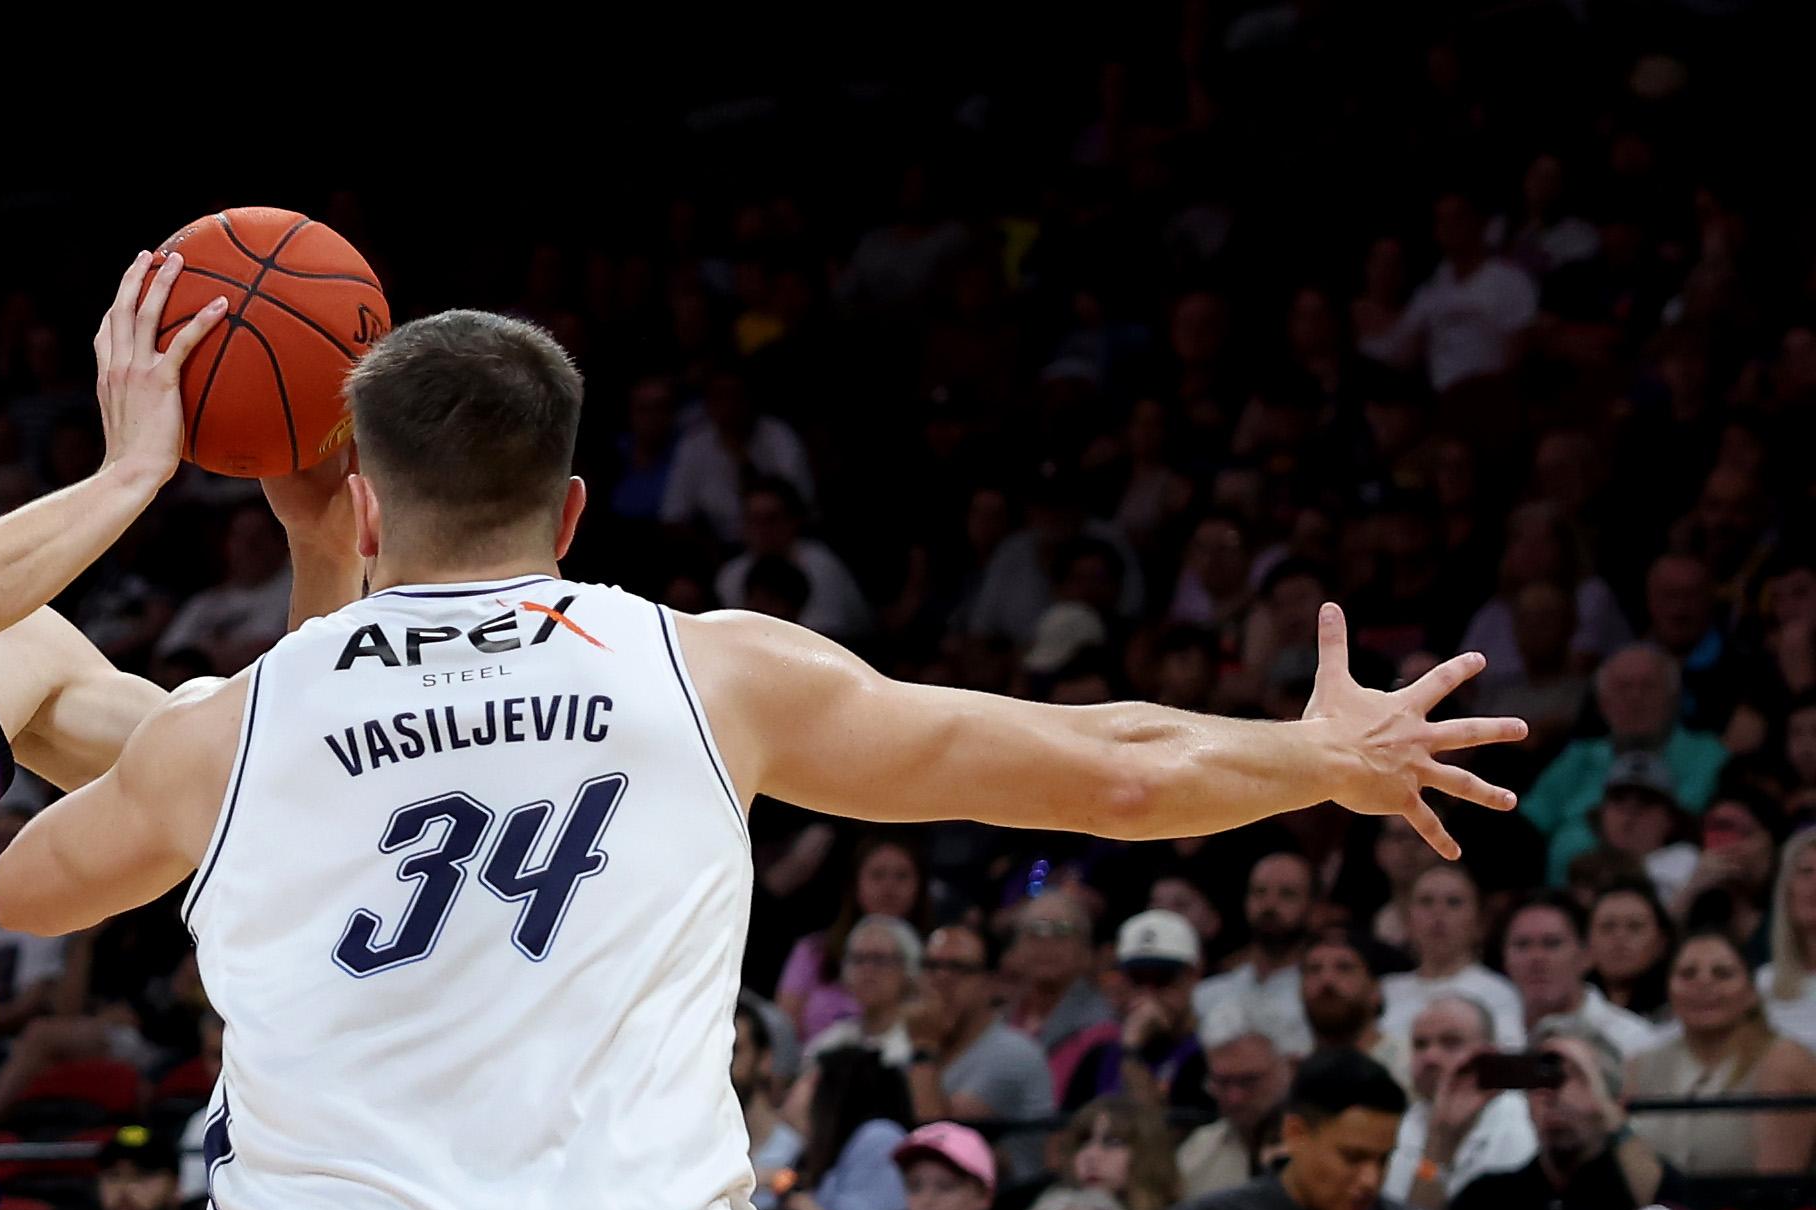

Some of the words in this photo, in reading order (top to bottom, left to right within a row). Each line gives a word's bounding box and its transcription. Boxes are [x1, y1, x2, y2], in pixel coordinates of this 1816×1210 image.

[422, 664, 512, 688] STEEL
[323, 694, 614, 777] VASILJEVIC
[330, 771, 629, 979] 34
